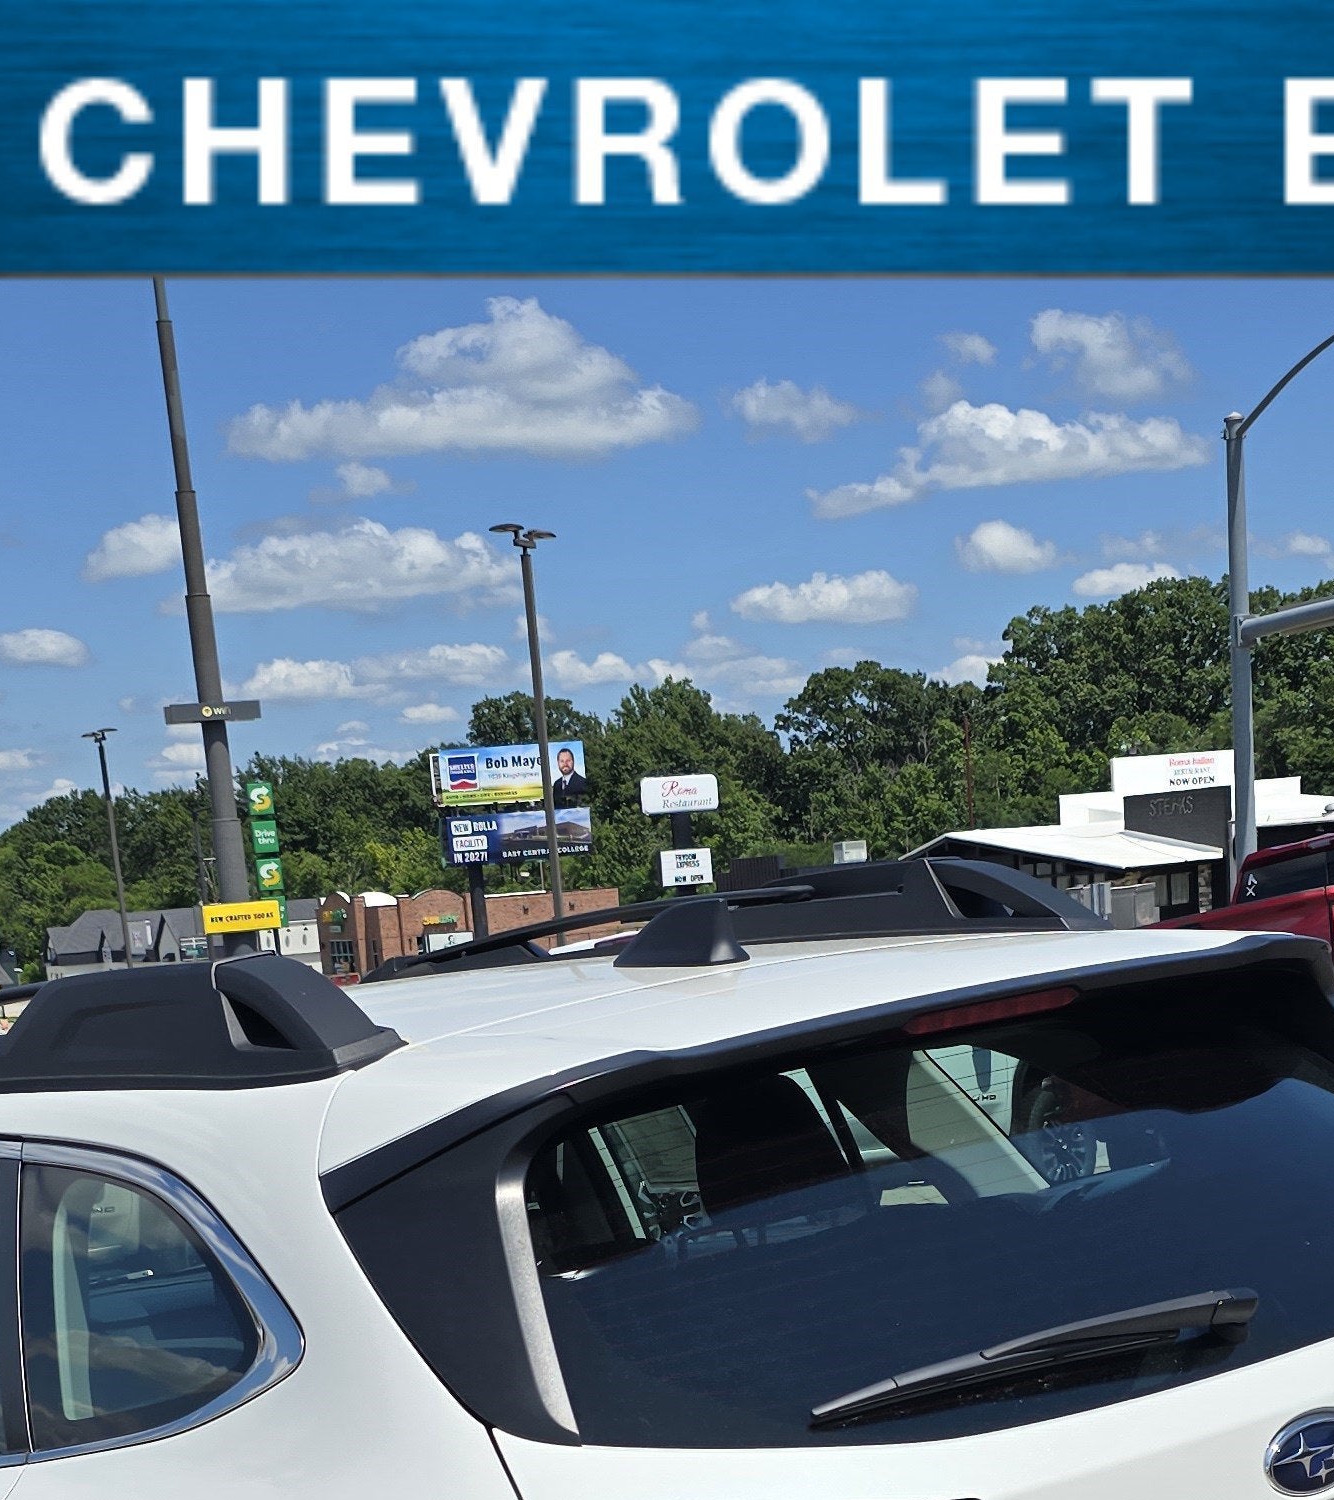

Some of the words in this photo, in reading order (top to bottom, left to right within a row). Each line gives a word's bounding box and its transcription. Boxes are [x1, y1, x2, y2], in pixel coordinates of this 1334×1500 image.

[485, 756, 509, 769] Bob
[1169, 777, 1190, 787] NOW
[1192, 775, 1215, 785] OPEN
[662, 797, 713, 809] Restaurant
[454, 823, 469, 833] NEW
[254, 829, 276, 838] Drive
[257, 837, 275, 846] thru
[455, 838, 485, 848] FACILITY
[523, 848, 551, 857] CENTR
[557, 844, 589, 854] COLLEGE
[454, 853, 463, 864] IN
[690, 874, 704, 882] OPEN
[225, 914, 252, 923] CRAFTED
